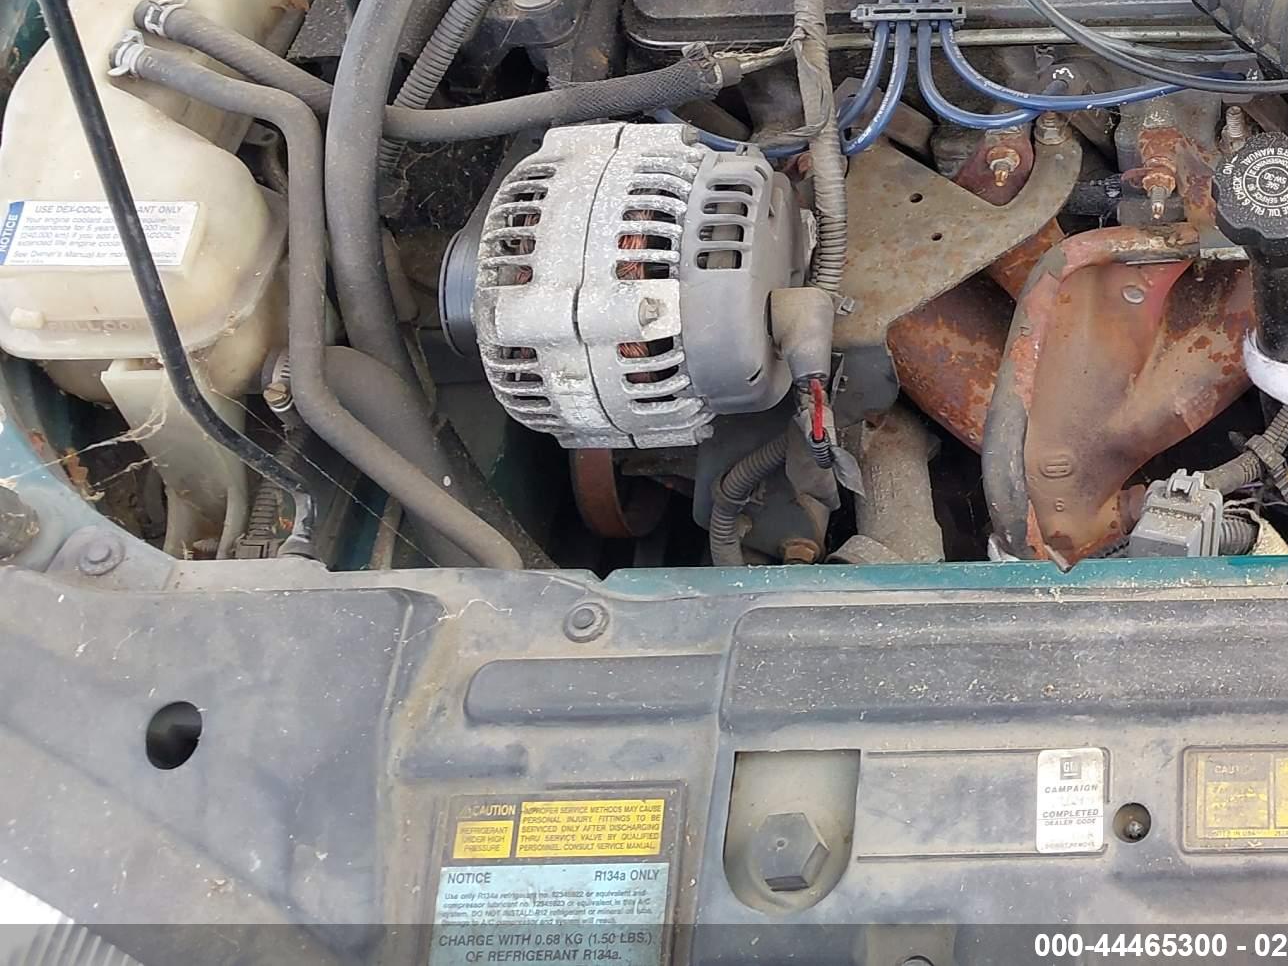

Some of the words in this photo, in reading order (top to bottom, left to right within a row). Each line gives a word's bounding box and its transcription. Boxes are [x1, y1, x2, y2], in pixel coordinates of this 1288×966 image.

[1241, 147, 1275, 166] MANUAL
[1232, 176, 1246, 201] CHECK
[35, 205, 53, 213] USE
[1250, 203, 1265, 216] FILL
[1269, 208, 1282, 217] OIL
[0, 215, 18, 252] NOTICE
[1045, 784, 1098, 793] CAMPAIGN
[472, 804, 516, 816] CAUTION
[560, 806, 588, 814] SERVICE
[624, 805, 637, 813] MAY
[1043, 809, 1099, 818] COMPLETED
[522, 816, 561, 824] PERSONAL
[636, 814, 647, 822] TO
[561, 825, 580, 833] ONLY
[583, 824, 606, 832] AFTER
[609, 823, 660, 832] DISCHARGING
[544, 834, 576, 842] SERVICE
[581, 833, 603, 841] VALVE
[620, 832, 660, 840] QUALIFIED
[597, 842, 624, 850] SERVICE
[447, 872, 491, 884] NOTICE
[594, 870, 626, 882] R134a
[630, 869, 660, 881] ONLY
[438, 934, 494, 947] CHARGE
[498, 934, 532, 946] WITH
[534, 933, 561, 945] 0.68
[564, 933, 584, 945] KG
[620, 932, 653, 945] LBS.)
[466, 950, 483, 963] OF
[488, 949, 579, 962] REFRIGERANT
